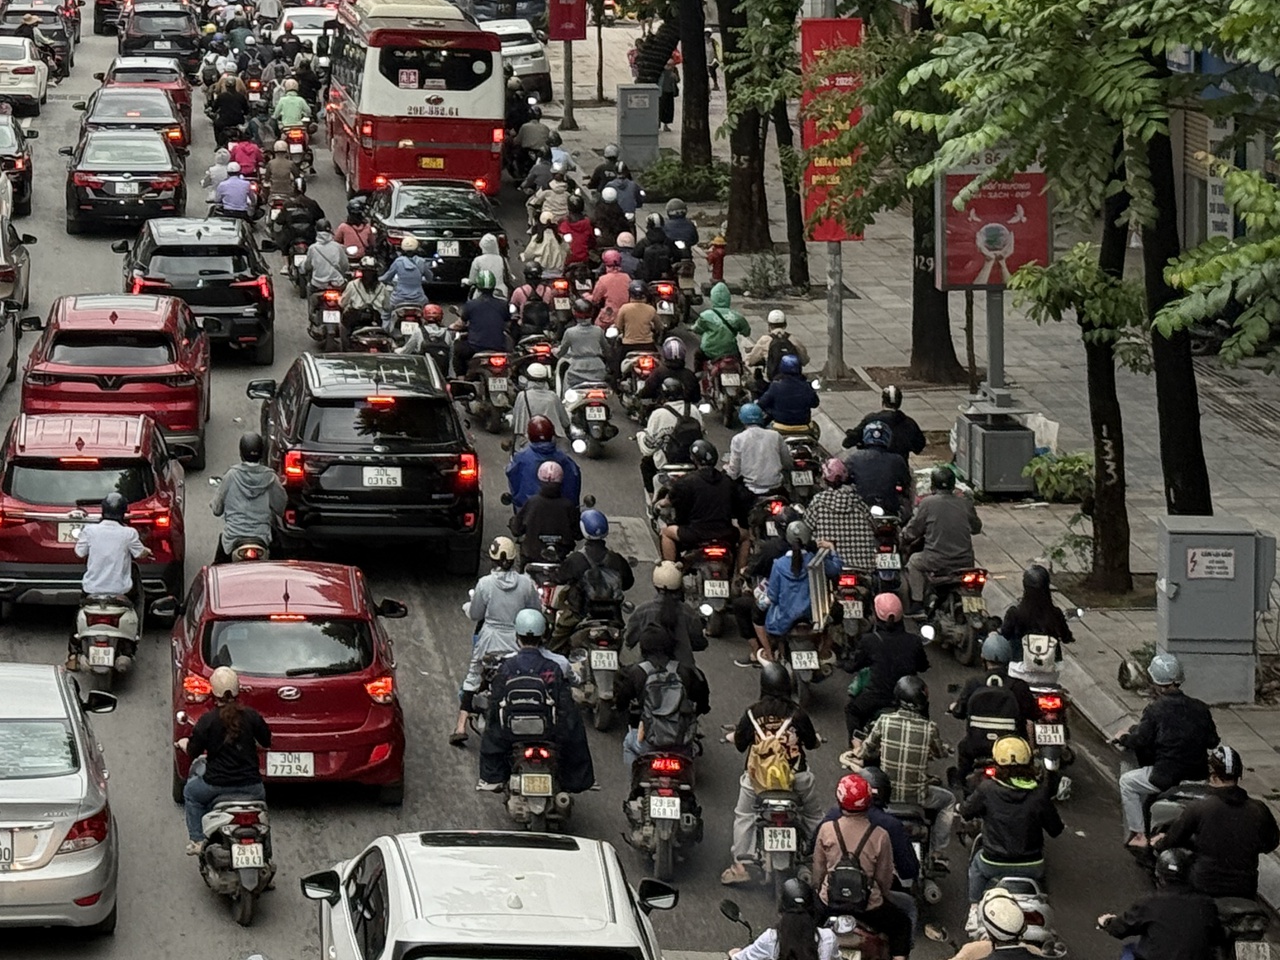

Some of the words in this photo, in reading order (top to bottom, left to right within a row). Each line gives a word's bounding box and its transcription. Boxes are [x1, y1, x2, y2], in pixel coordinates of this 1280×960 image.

[915, 255, 934, 271] 129
[375, 468, 391, 476] 30L
[280, 753, 301, 763] 30H
